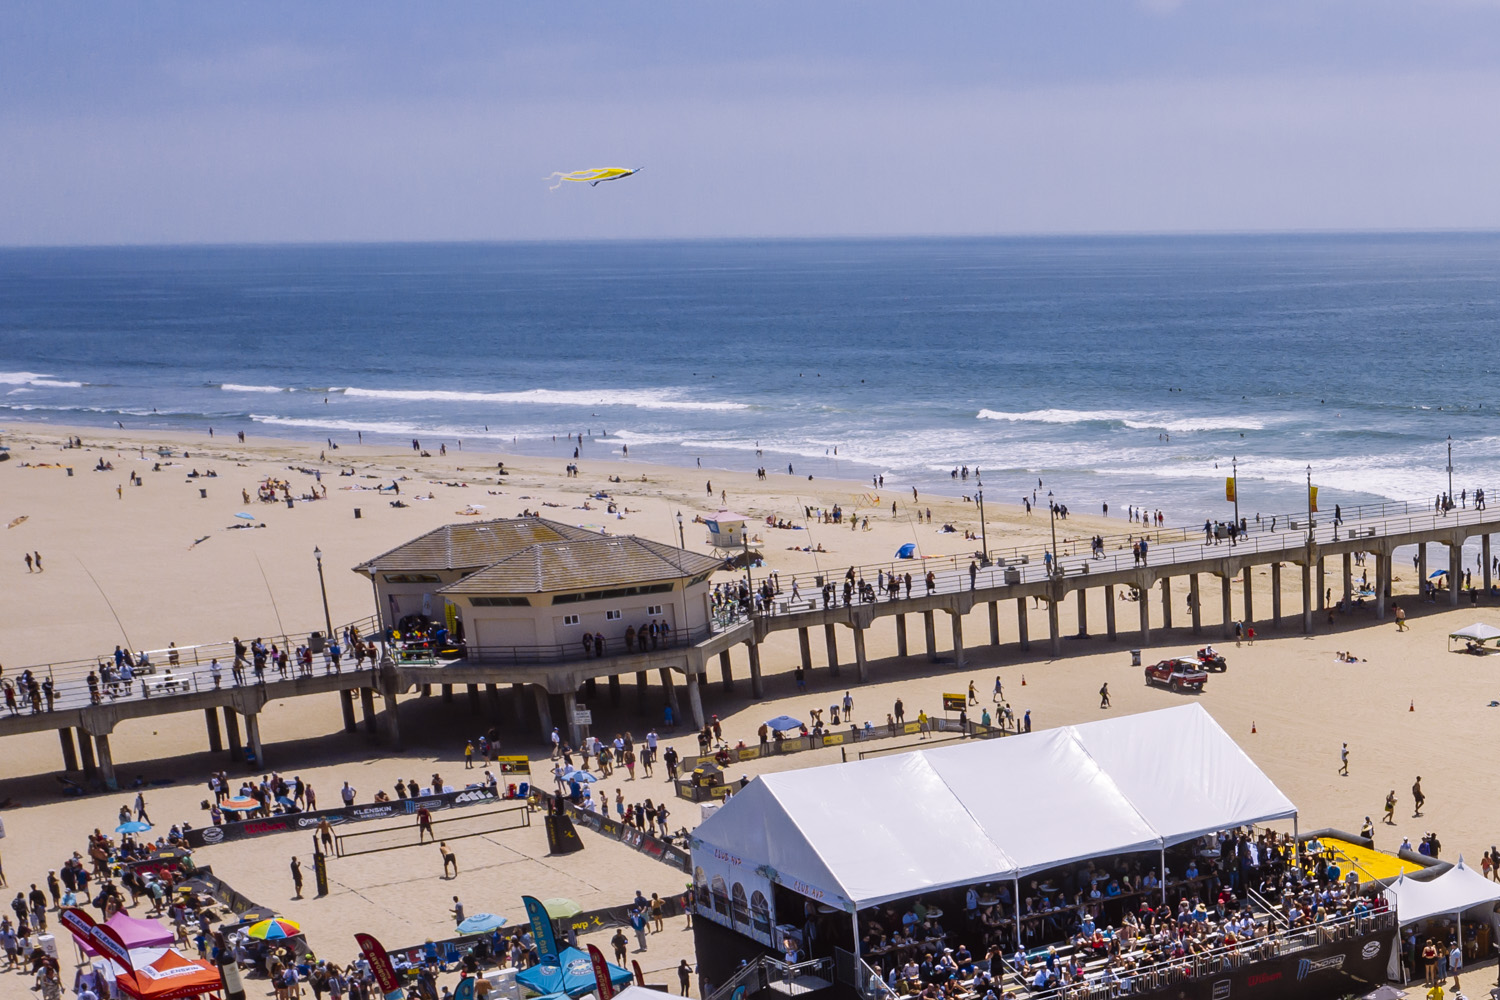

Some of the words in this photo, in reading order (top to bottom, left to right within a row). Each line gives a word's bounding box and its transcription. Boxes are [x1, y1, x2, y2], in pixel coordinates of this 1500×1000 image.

[533, 916, 544, 939] WAVE
[571, 920, 588, 931] avp
[541, 938, 549, 954] BIG
